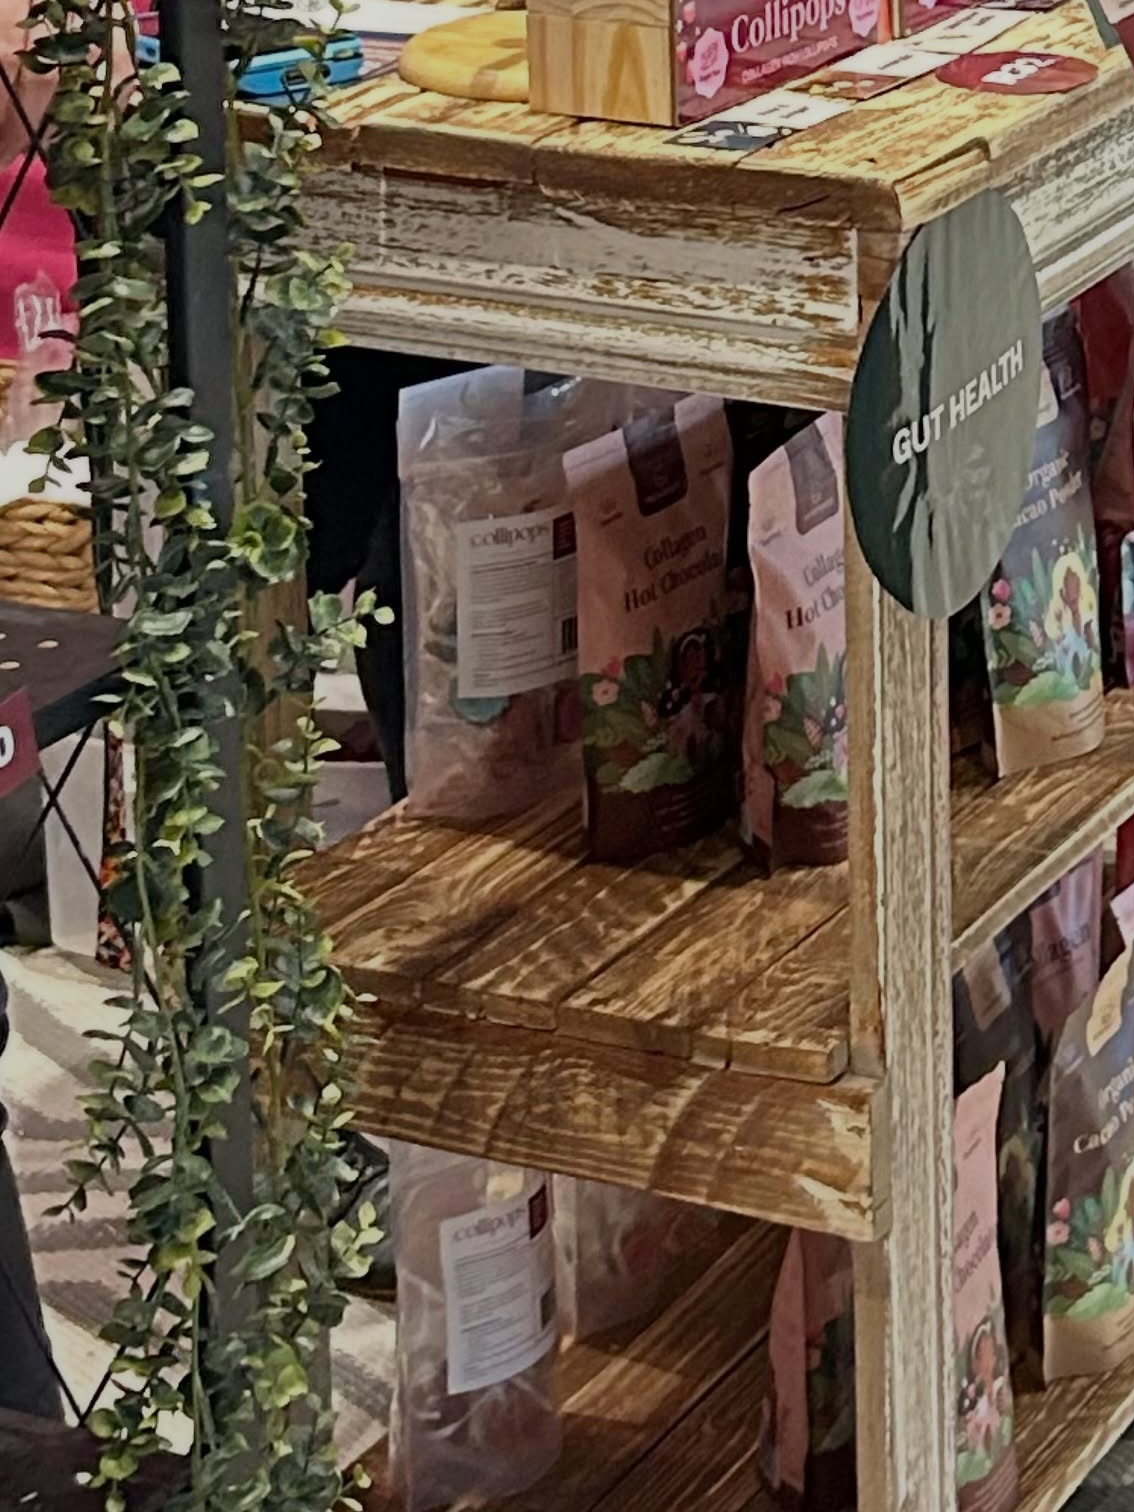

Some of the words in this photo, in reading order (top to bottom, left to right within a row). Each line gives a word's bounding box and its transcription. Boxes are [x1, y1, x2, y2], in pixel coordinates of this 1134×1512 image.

[892, 406, 946, 465] GUT
[948, 340, 1024, 431] HEALTH
[643, 526, 707, 570] Collagen
[624, 583, 658, 613] Hot
[784, 598, 819, 631] Hot
